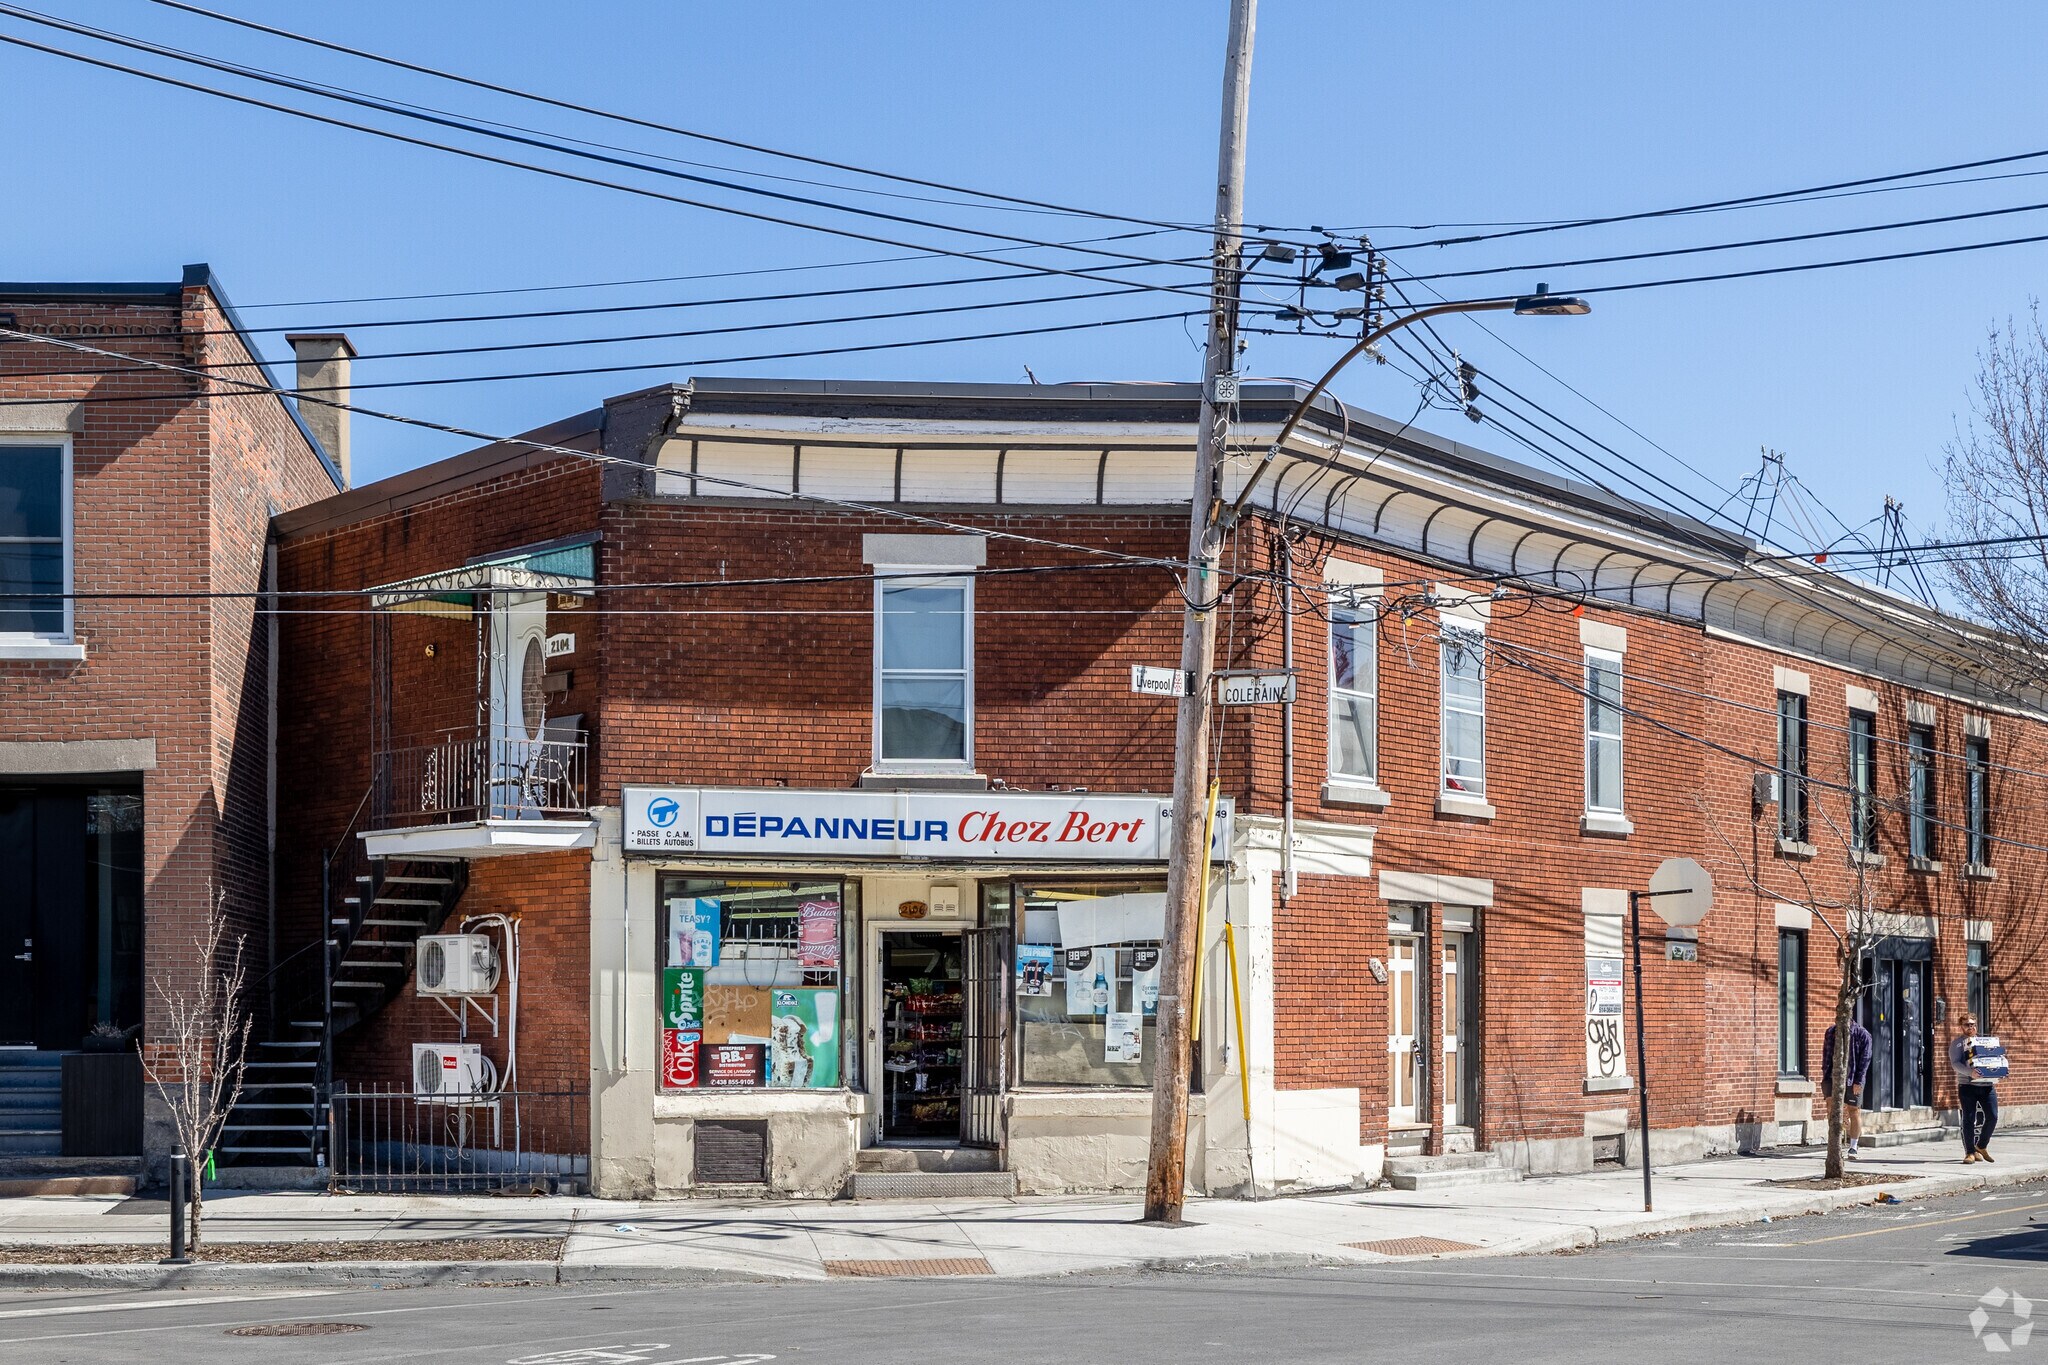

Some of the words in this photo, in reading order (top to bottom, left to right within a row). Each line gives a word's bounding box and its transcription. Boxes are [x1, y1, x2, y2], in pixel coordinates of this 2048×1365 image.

[550, 637, 570, 654] 2104
[1136, 674, 1171, 692] Liverpool
[1250, 678, 1263, 687] RUE
[1225, 686, 1288, 703] COLERAINE
[1215, 809, 1227, 819] 49
[637, 829, 660, 838] PASSE
[666, 830, 692, 839] C.A.M.
[705, 811, 948, 842] DÉPANNEUR
[957, 810, 1052, 843] Chez
[1054, 810, 1146, 843] Bert
[636, 837, 661, 846] BILLETS
[664, 838, 694, 847] AUTOBUS
[679, 914, 711, 924] TEASY?
[669, 972, 698, 1025] Sprite
[669, 1037, 695, 1085] Cok
